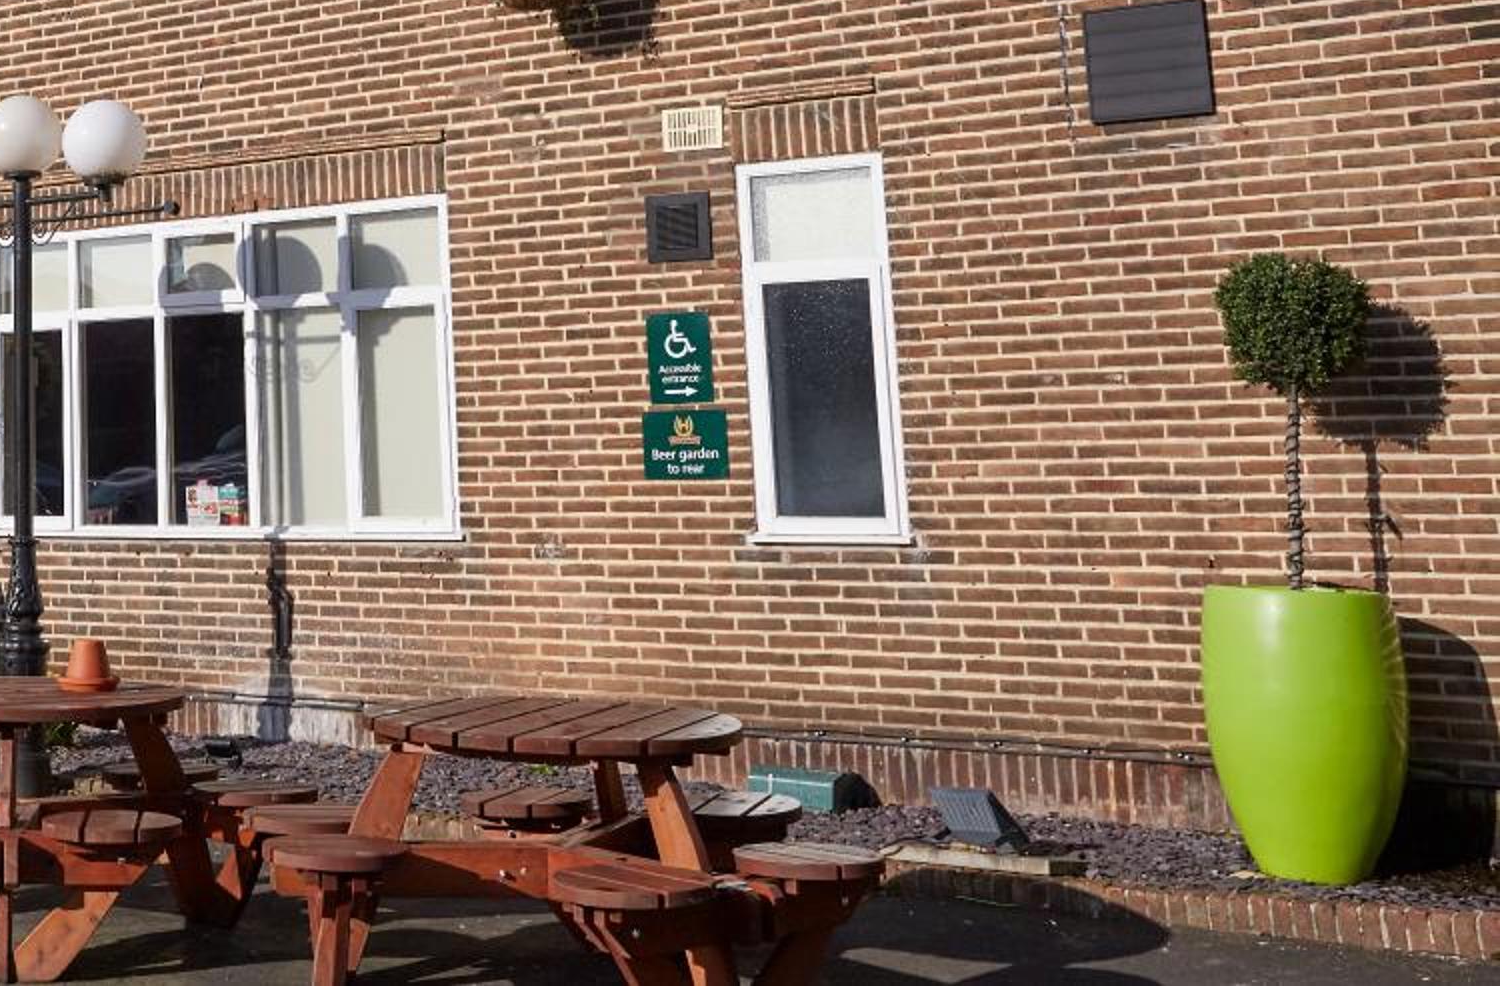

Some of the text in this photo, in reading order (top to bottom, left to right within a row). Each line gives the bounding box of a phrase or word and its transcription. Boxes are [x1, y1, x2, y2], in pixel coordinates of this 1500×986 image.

[661, 375, 699, 383] entrance
[651, 446, 719, 463] Beer garden
[667, 463, 705, 474] to rear
